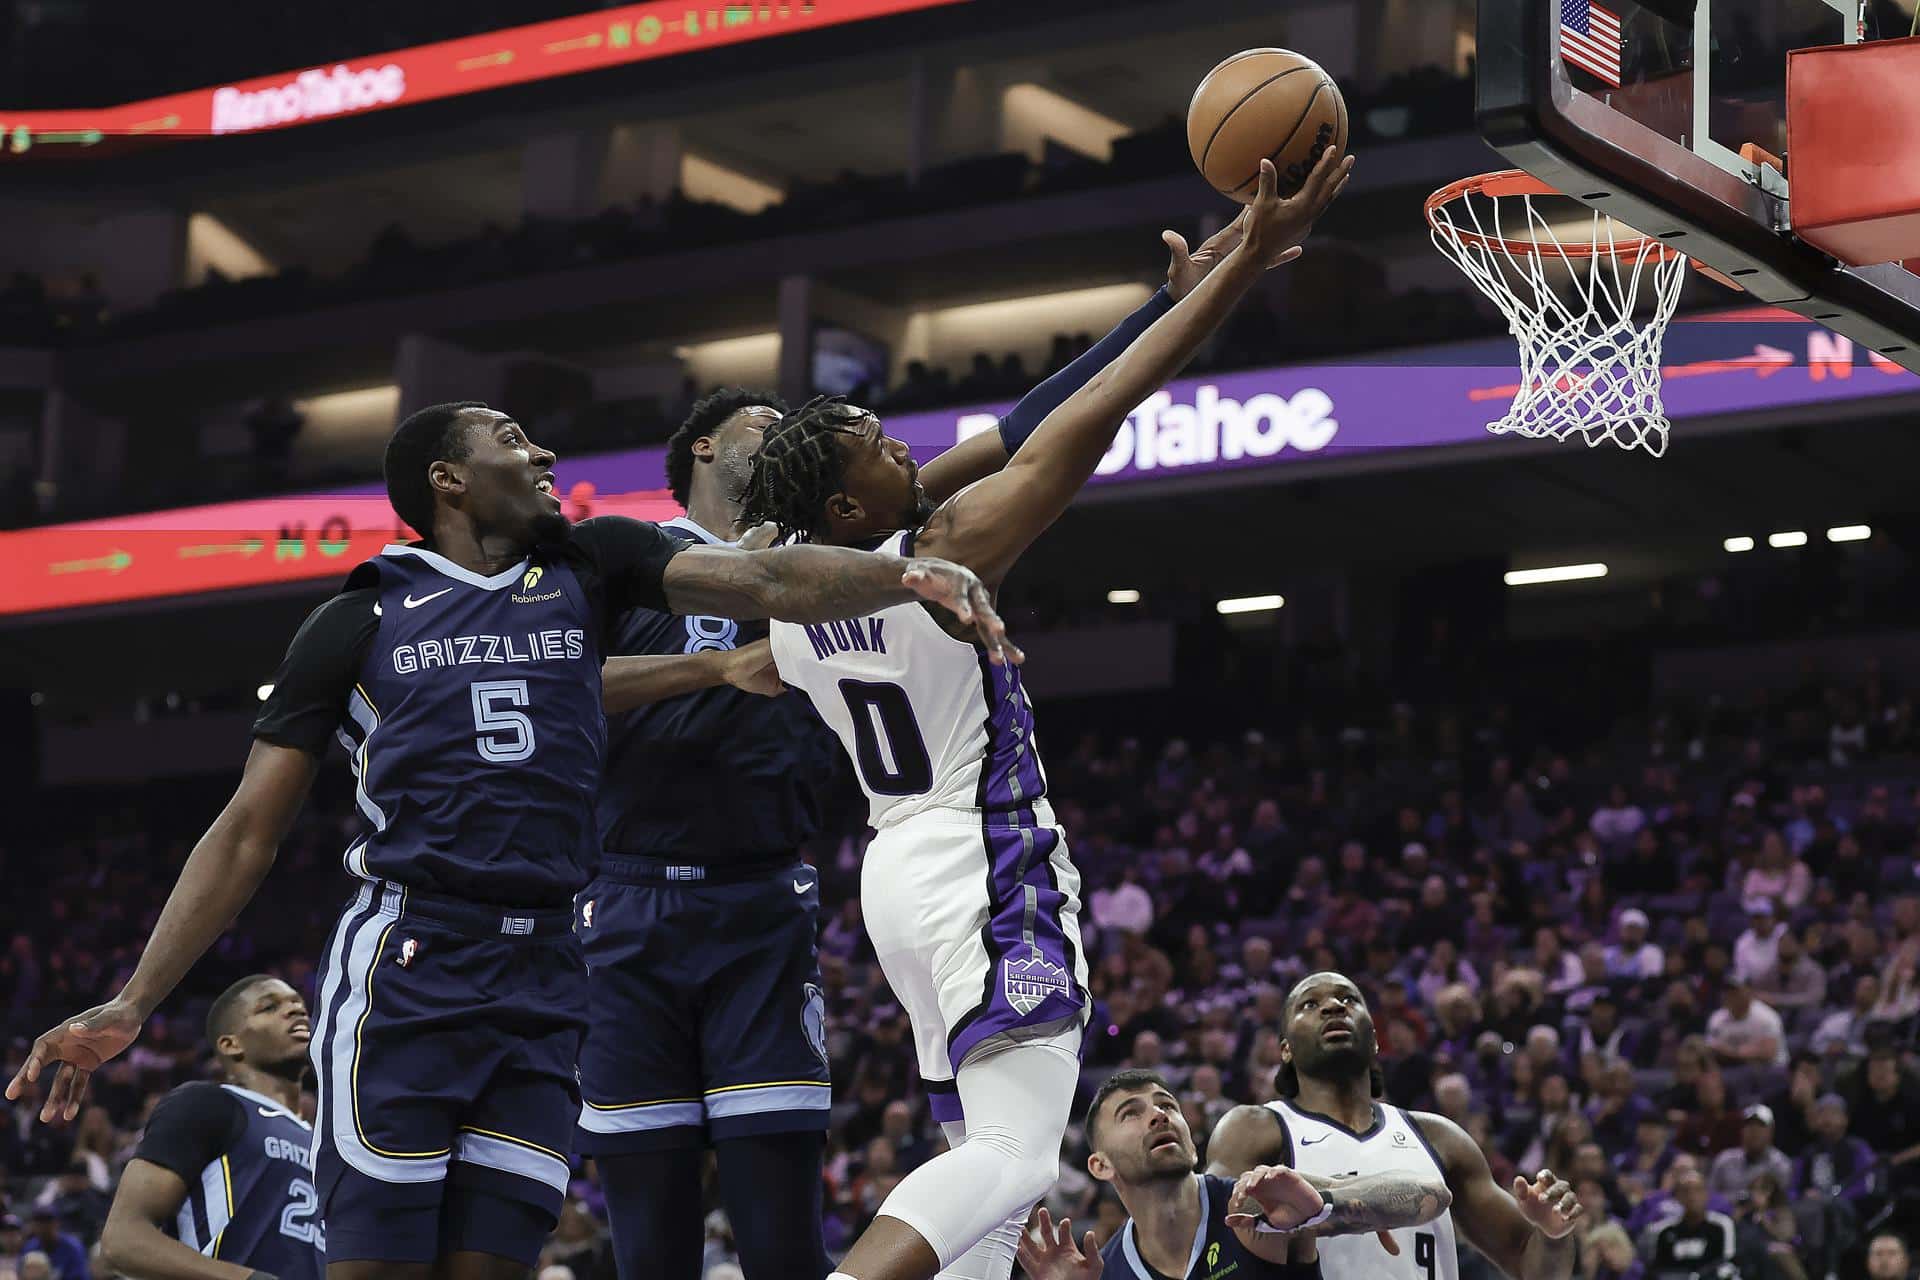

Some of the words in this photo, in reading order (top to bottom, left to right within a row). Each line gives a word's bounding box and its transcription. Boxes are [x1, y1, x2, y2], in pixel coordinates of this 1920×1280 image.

[511, 588, 561, 603] Robinhood
[393, 629, 584, 674] GRIZZLIES
[684, 615, 738, 654] 8
[471, 680, 536, 762] 5
[838, 678, 933, 796] 0
[1009, 973, 1066, 986] SACRAMENTO
[279, 1178, 326, 1254] 2
[1415, 1231, 1436, 1280] 9
